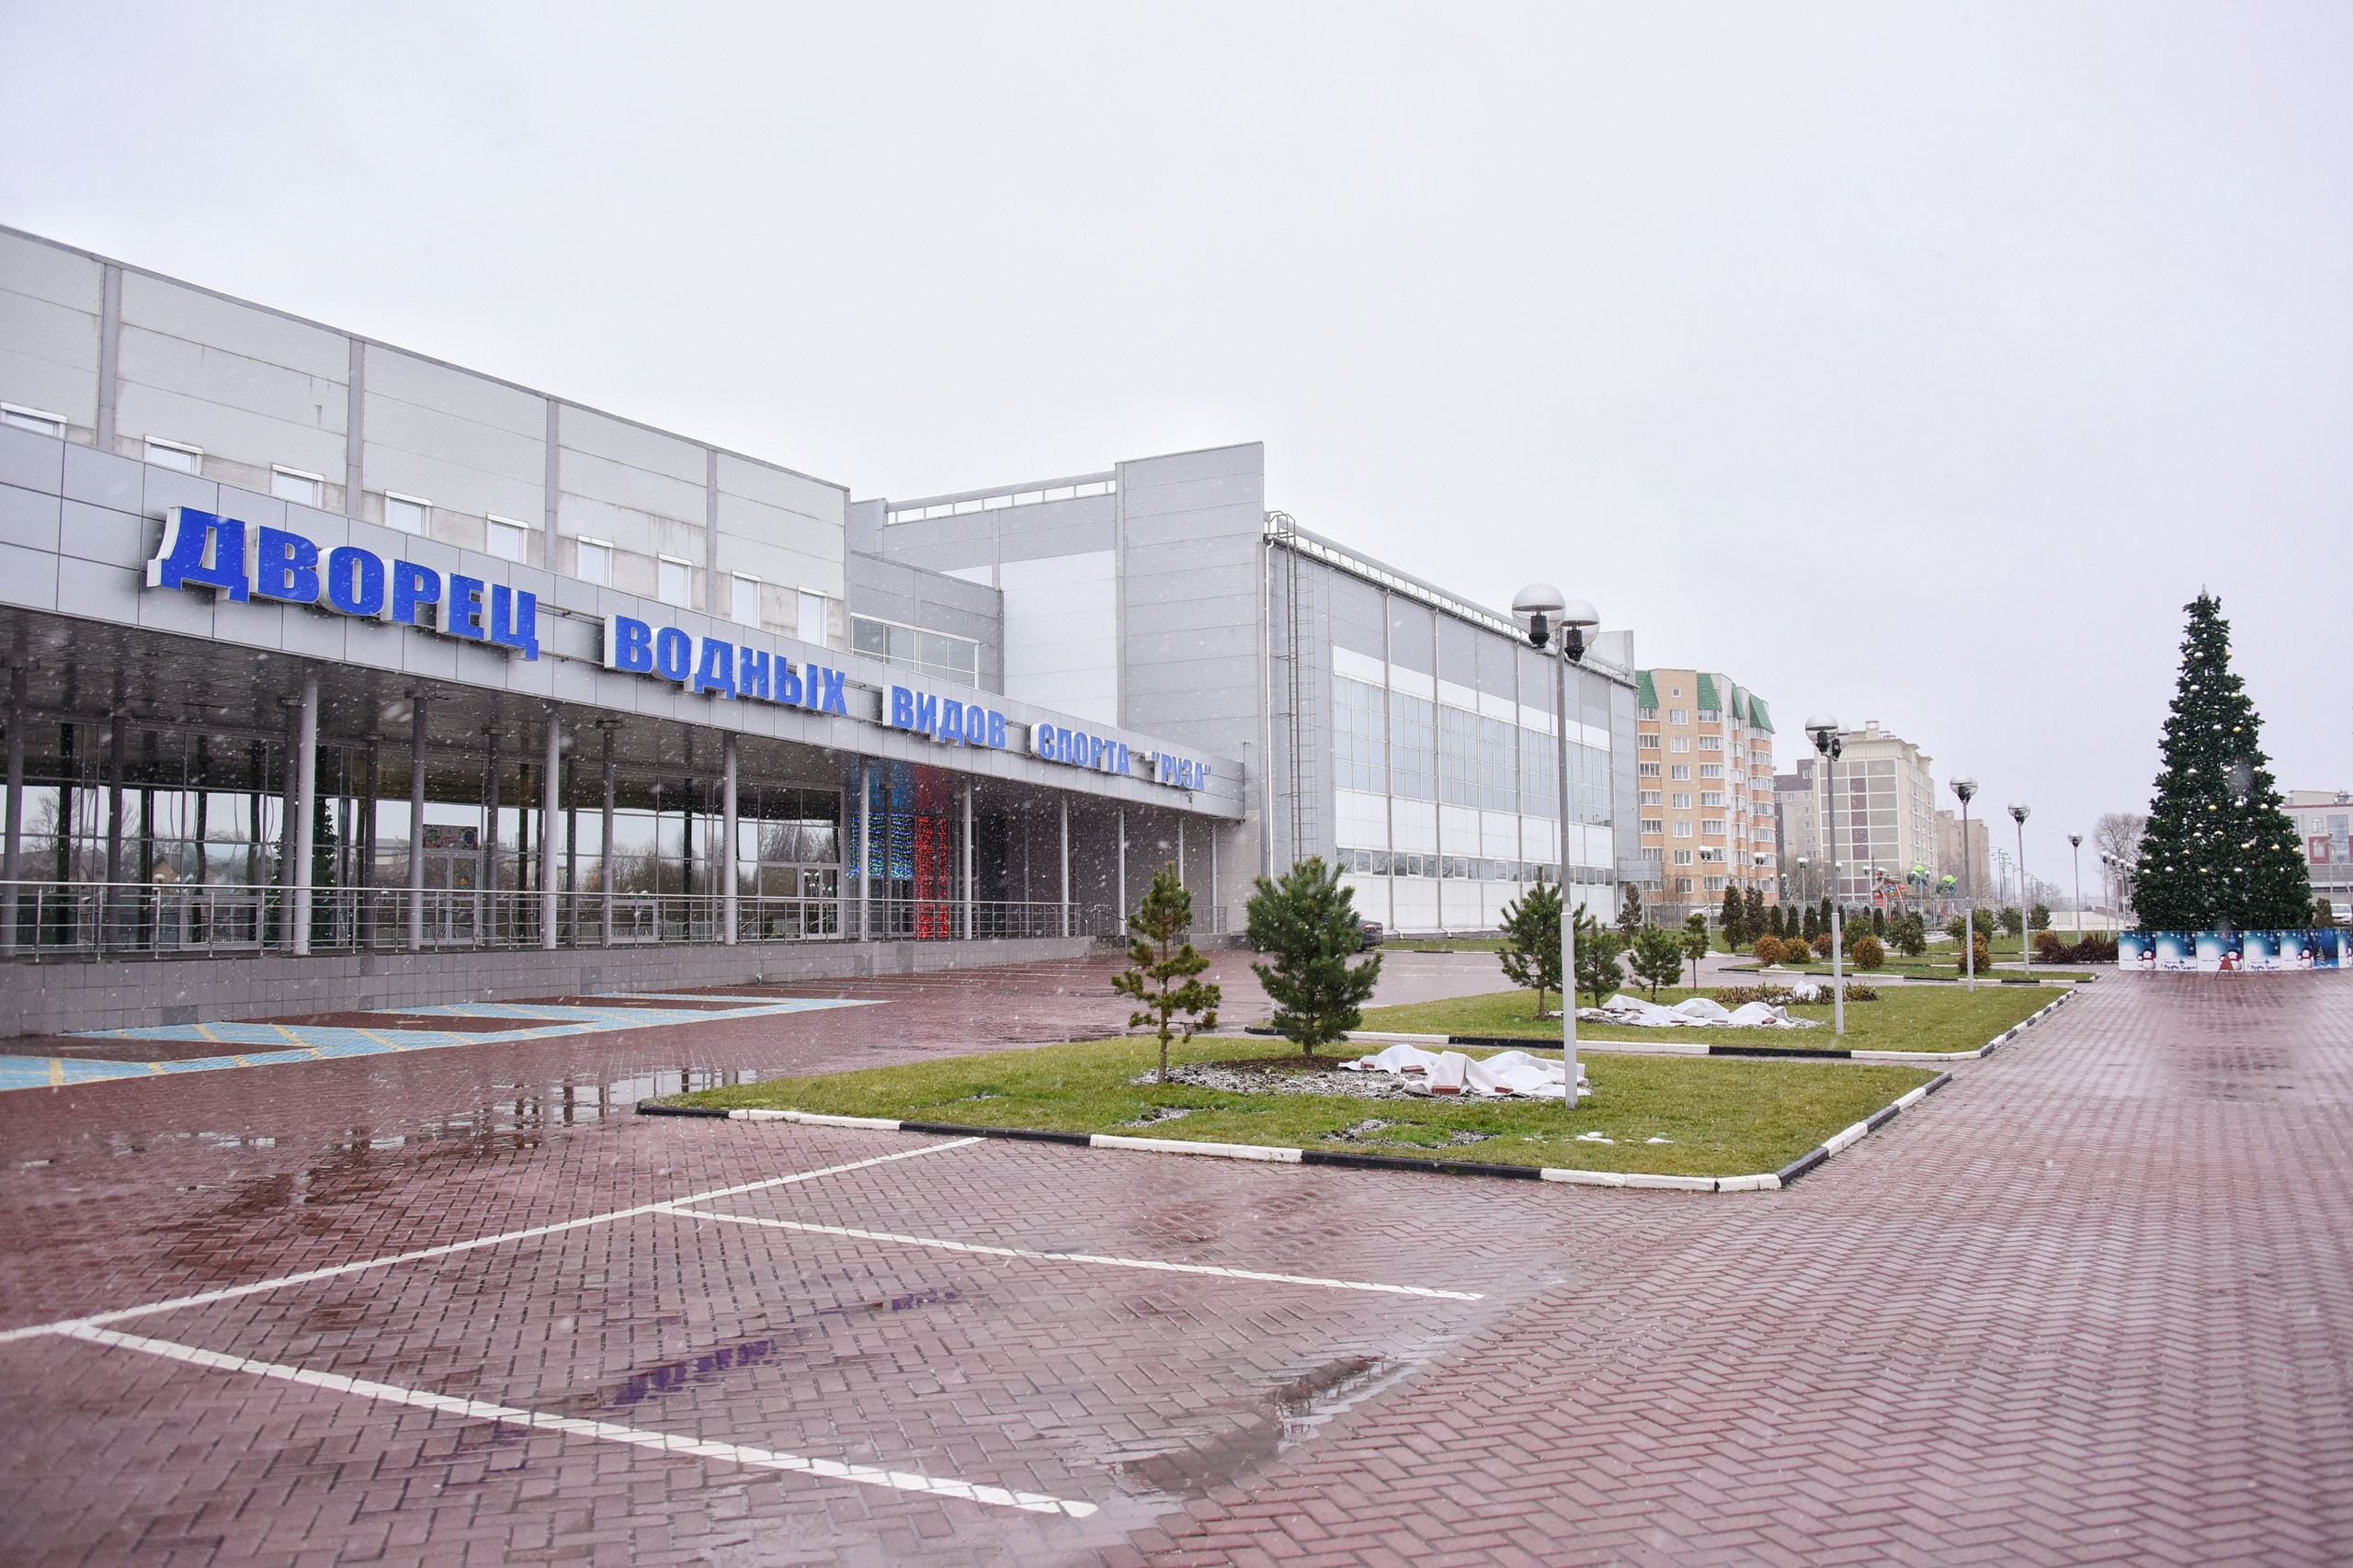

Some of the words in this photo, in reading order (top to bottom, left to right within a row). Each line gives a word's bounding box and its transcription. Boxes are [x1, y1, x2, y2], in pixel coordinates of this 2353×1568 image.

[148, 506, 540, 662] ДВОРЕЦ
[605, 614, 848, 716] ВОДНЫХ
[883, 684, 1006, 749] ВИДОВ
[1031, 722, 1131, 776] СПОРТА
